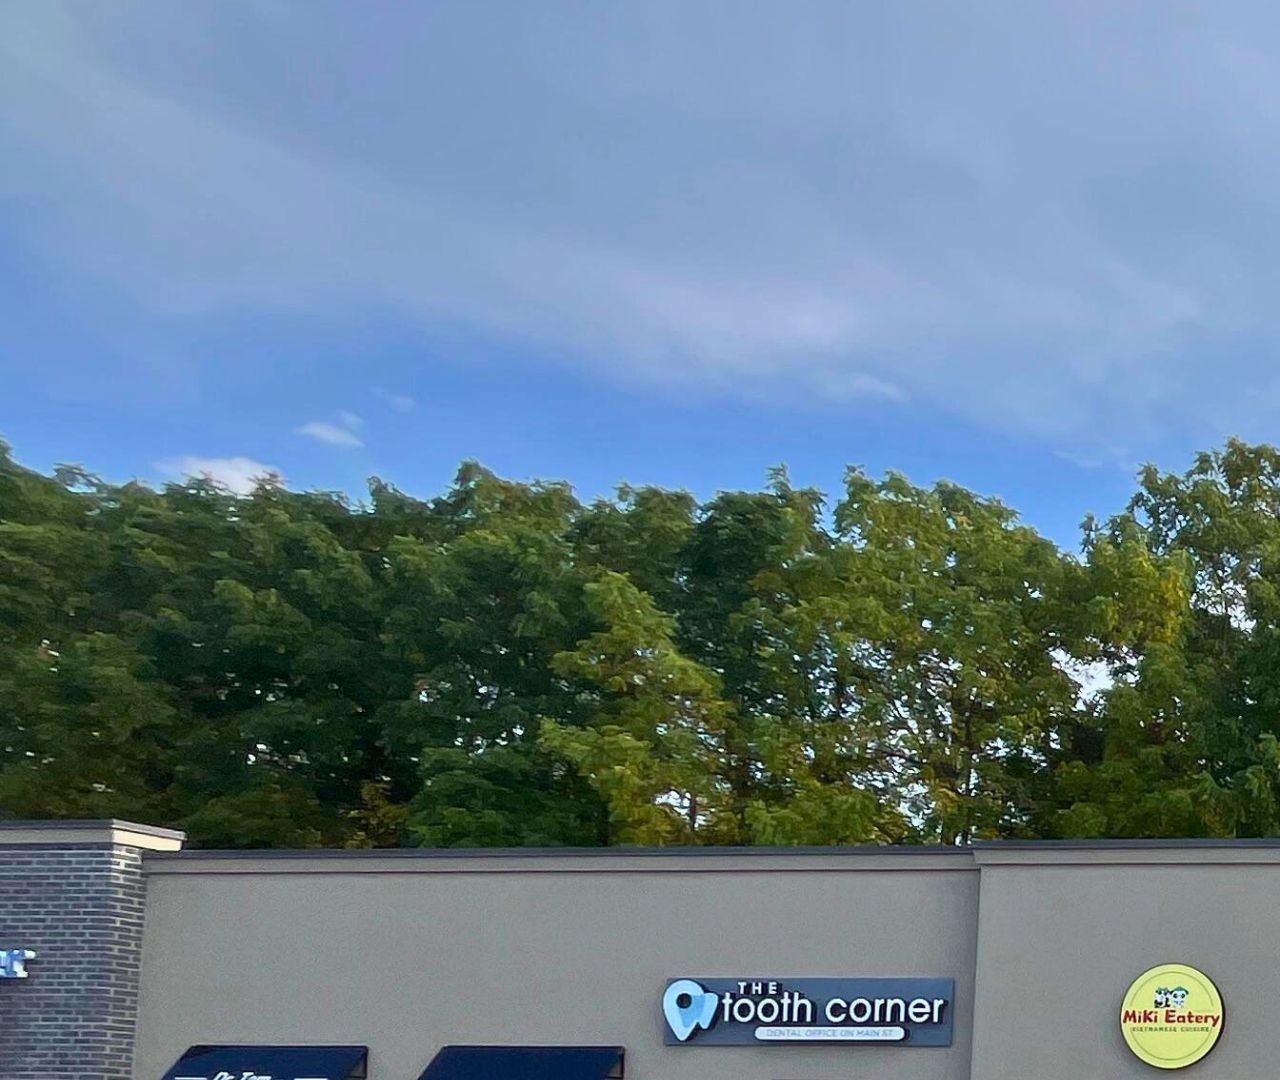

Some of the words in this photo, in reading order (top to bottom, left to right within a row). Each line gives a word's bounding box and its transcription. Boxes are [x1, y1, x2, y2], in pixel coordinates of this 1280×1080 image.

[737, 981, 778, 995] THE
[721, 992, 813, 1023] tooth
[825, 998, 945, 1023] corner
[1164, 1009, 1220, 1028] Eatery
[766, 1028, 801, 1038] DENTAL
[804, 1028, 836, 1038] OFFICE
[840, 1028, 854, 1038] ON
[856, 1028, 880, 1038] MAIN
